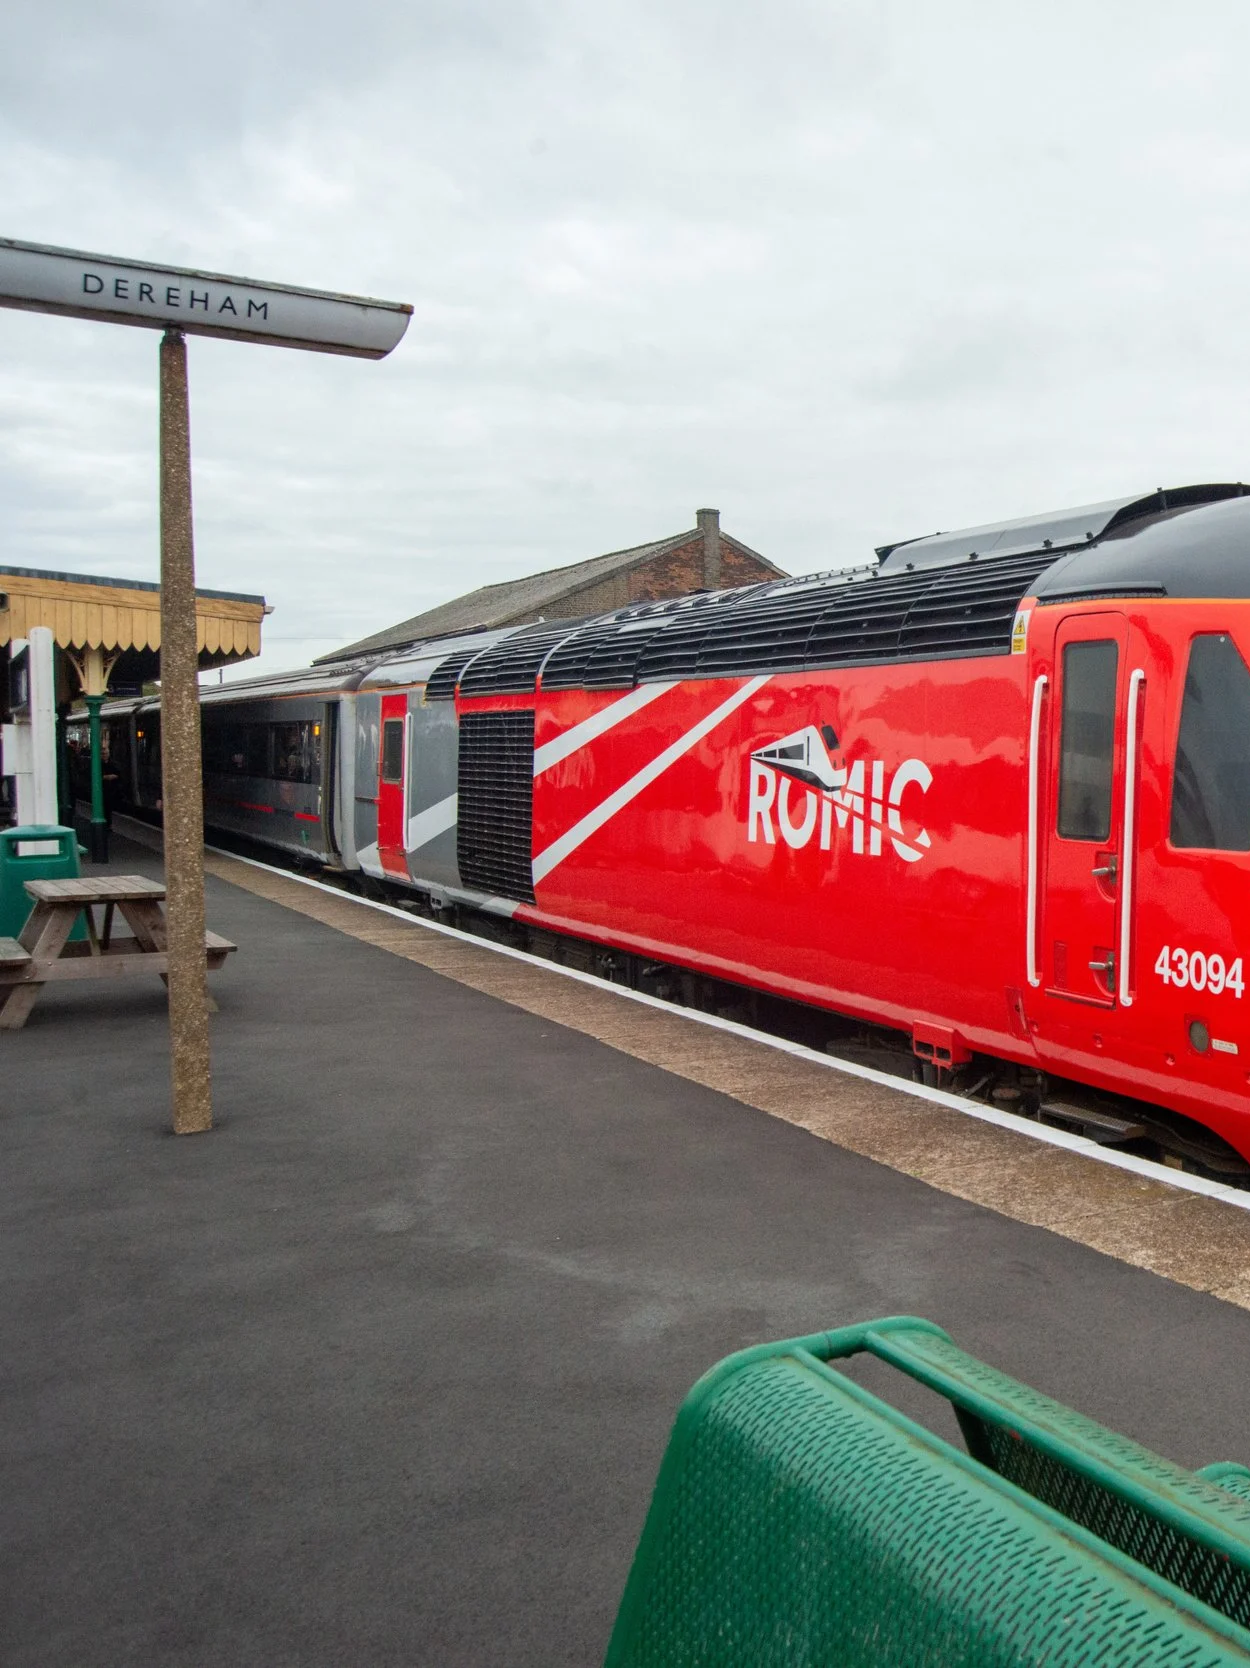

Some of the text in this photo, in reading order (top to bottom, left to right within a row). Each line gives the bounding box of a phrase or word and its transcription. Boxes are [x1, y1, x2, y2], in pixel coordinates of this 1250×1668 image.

[83, 274, 268, 320] DEREHAM
[748, 758, 933, 862] ROMIC
[1155, 945, 1245, 999] 43094
